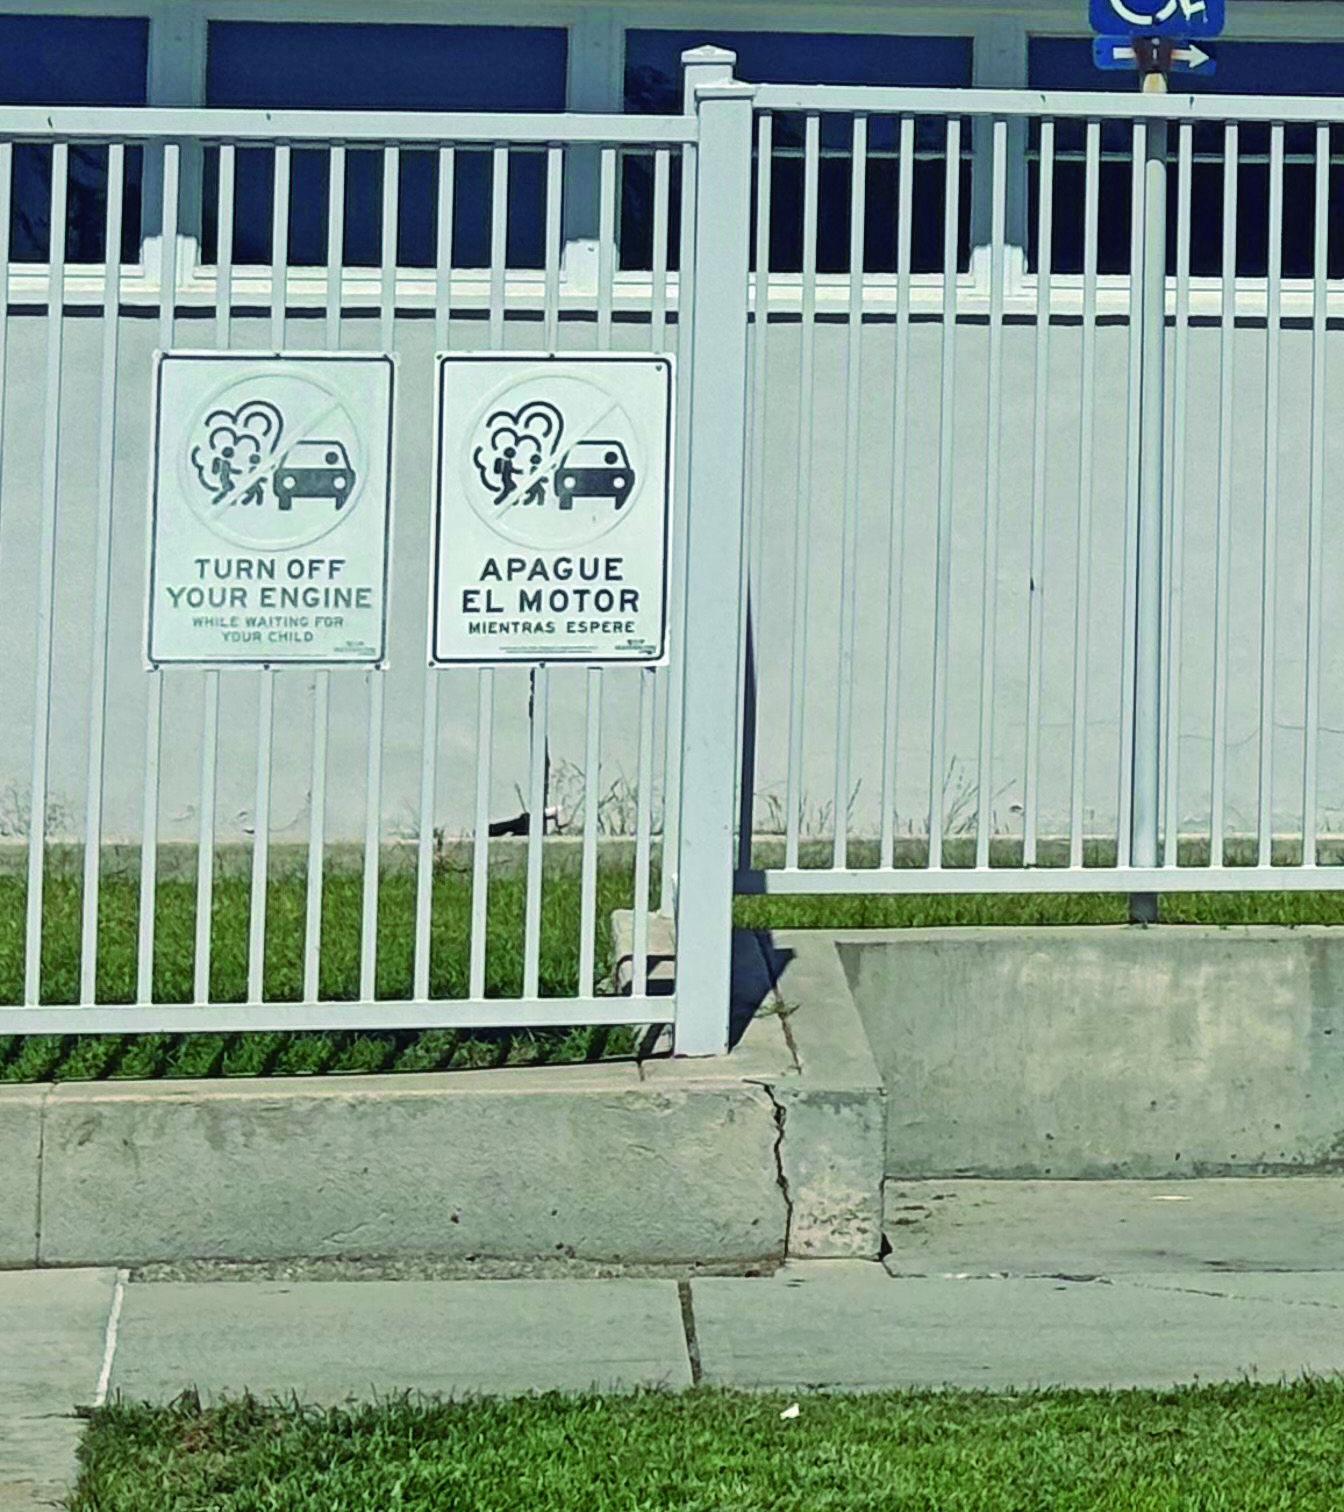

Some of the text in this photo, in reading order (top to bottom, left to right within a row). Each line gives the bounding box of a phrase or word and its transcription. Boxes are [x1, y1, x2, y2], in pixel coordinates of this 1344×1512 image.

[194, 558, 346, 580] TURN OFF
[479, 557, 624, 582] APAGUE
[166, 587, 373, 609] YOUR ENGINE
[462, 589, 640, 614] EL MOTOR
[192, 616, 344, 628] WHILE WAITING FOR
[468, 621, 636, 634] MIENTRAS ESPERE
[221, 631, 314, 644] YOUR CHILD
